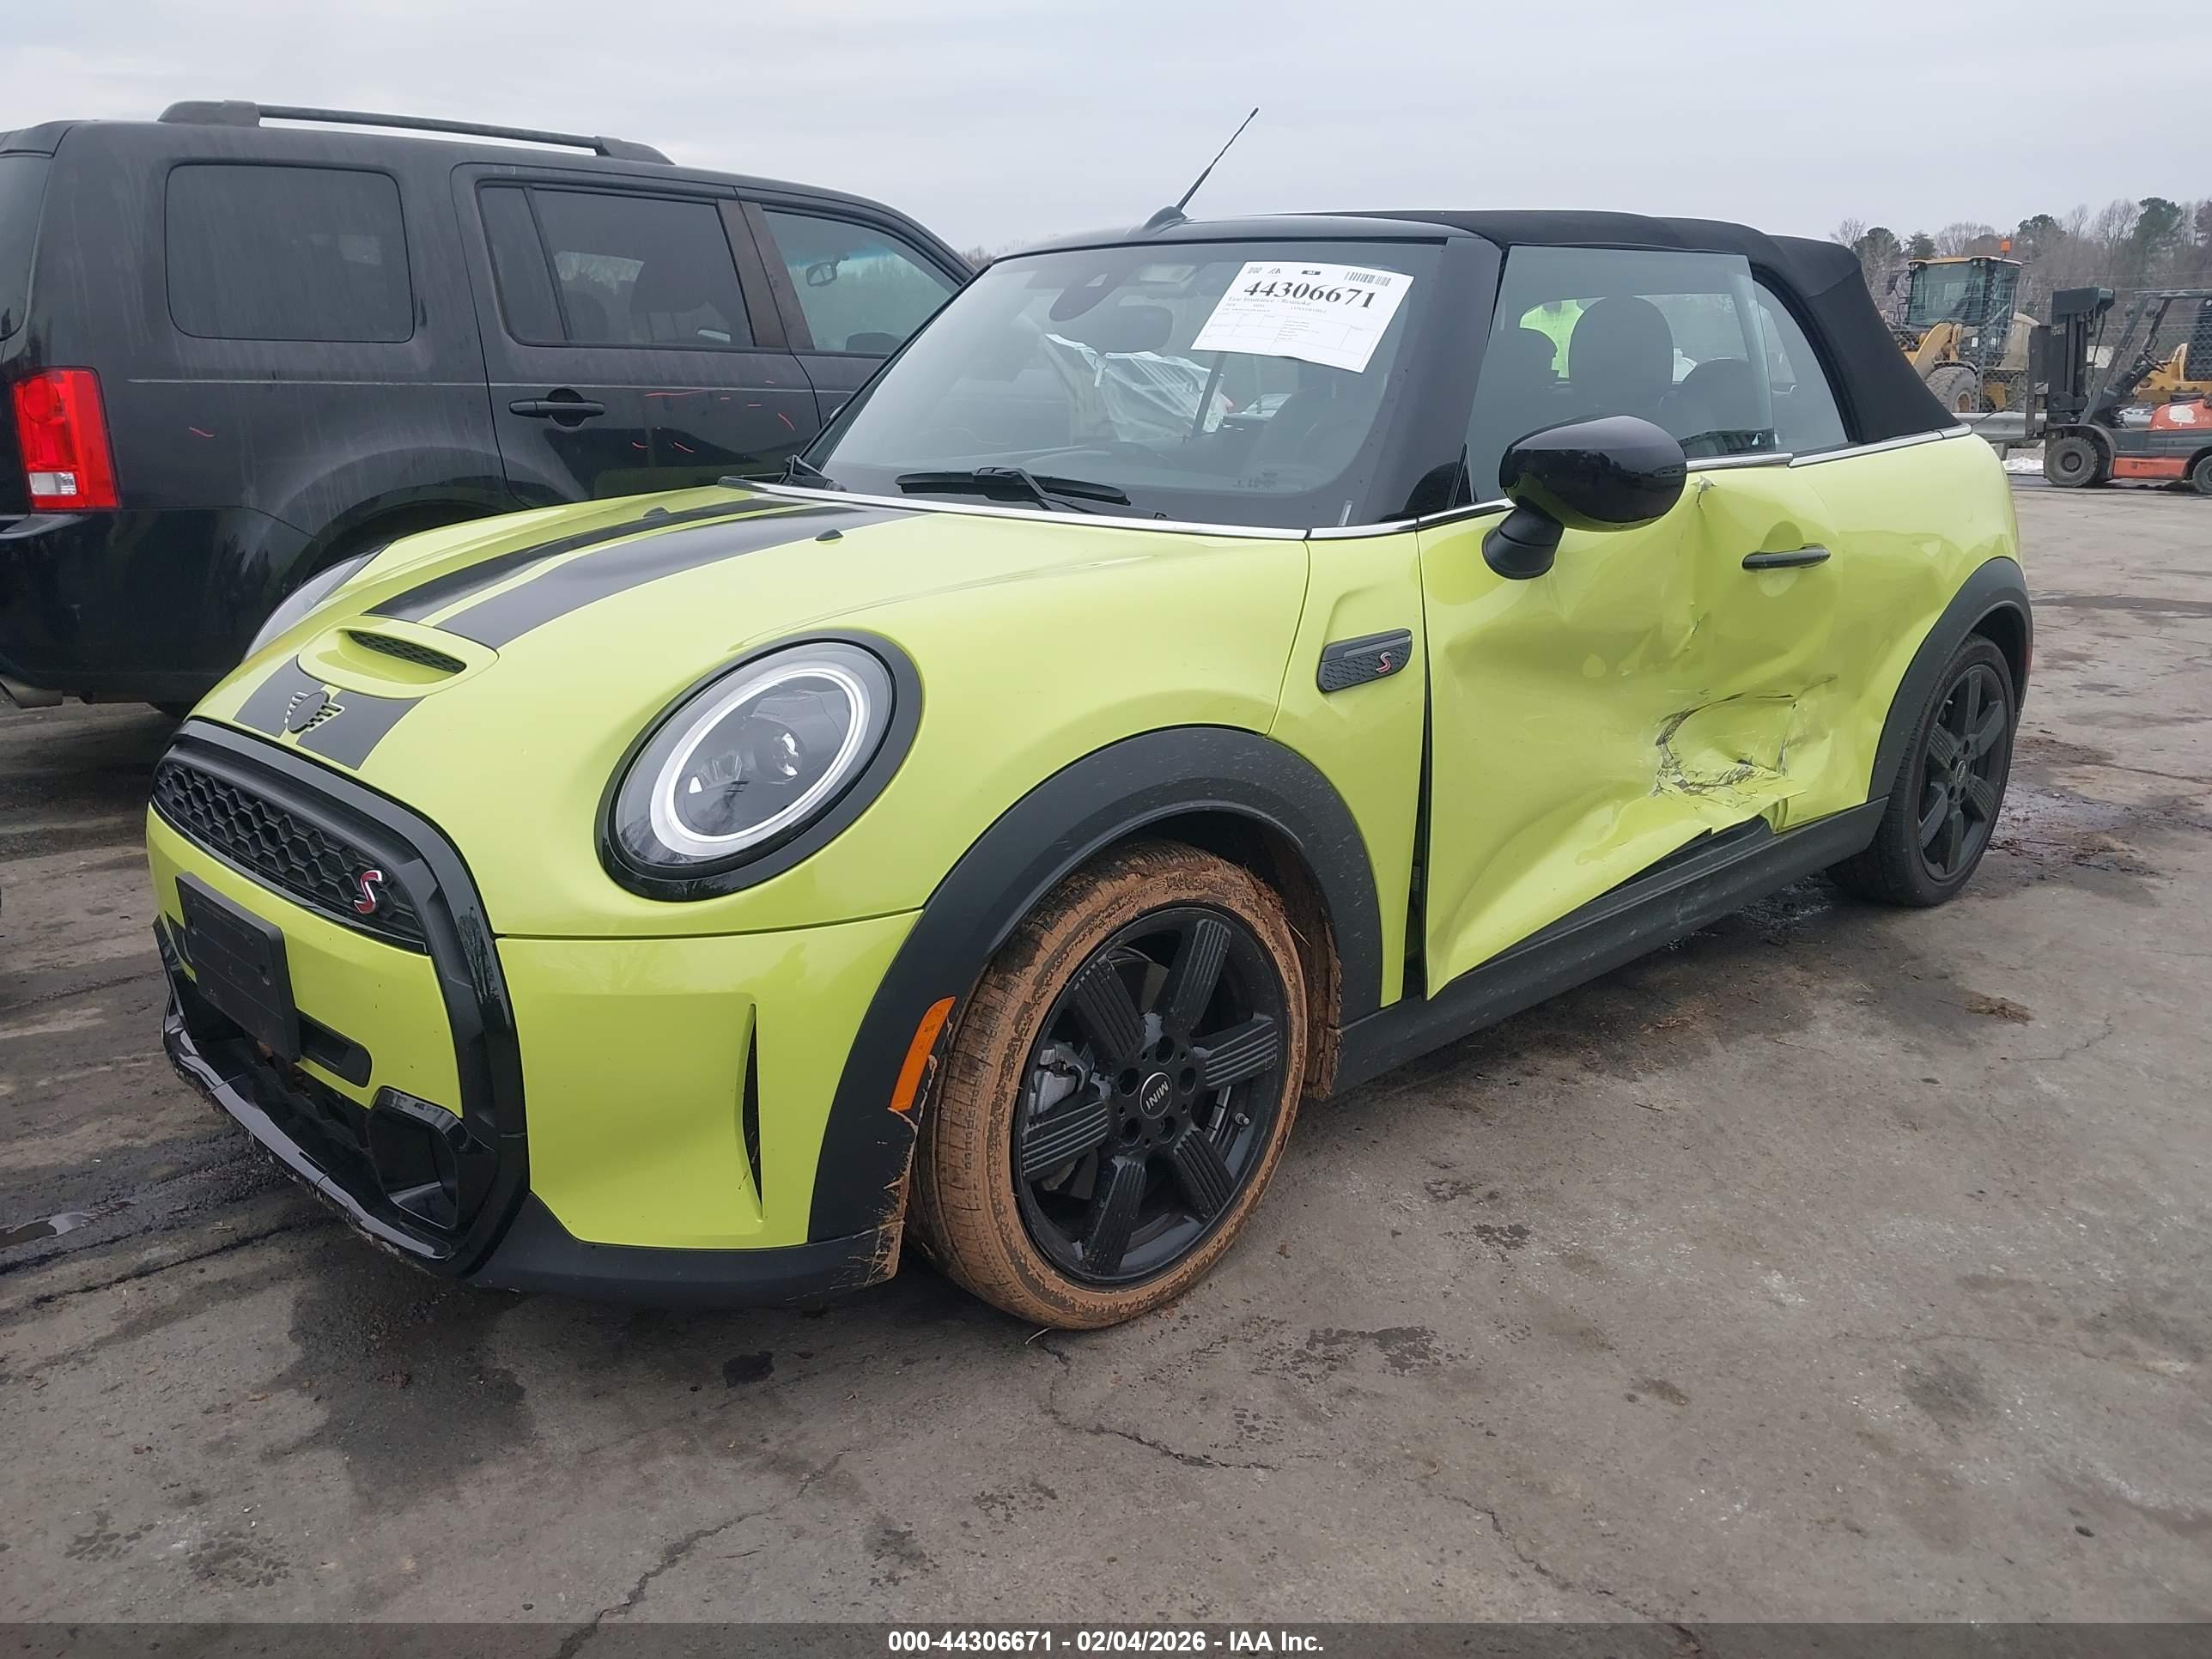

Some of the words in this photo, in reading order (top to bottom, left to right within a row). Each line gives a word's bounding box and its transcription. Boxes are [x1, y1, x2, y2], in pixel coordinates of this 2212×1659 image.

[1244, 281, 1376, 309] 44306671
[1376, 652, 1391, 673] S
[353, 869, 383, 915] S
[1146, 1080, 1169, 1109] MINI
